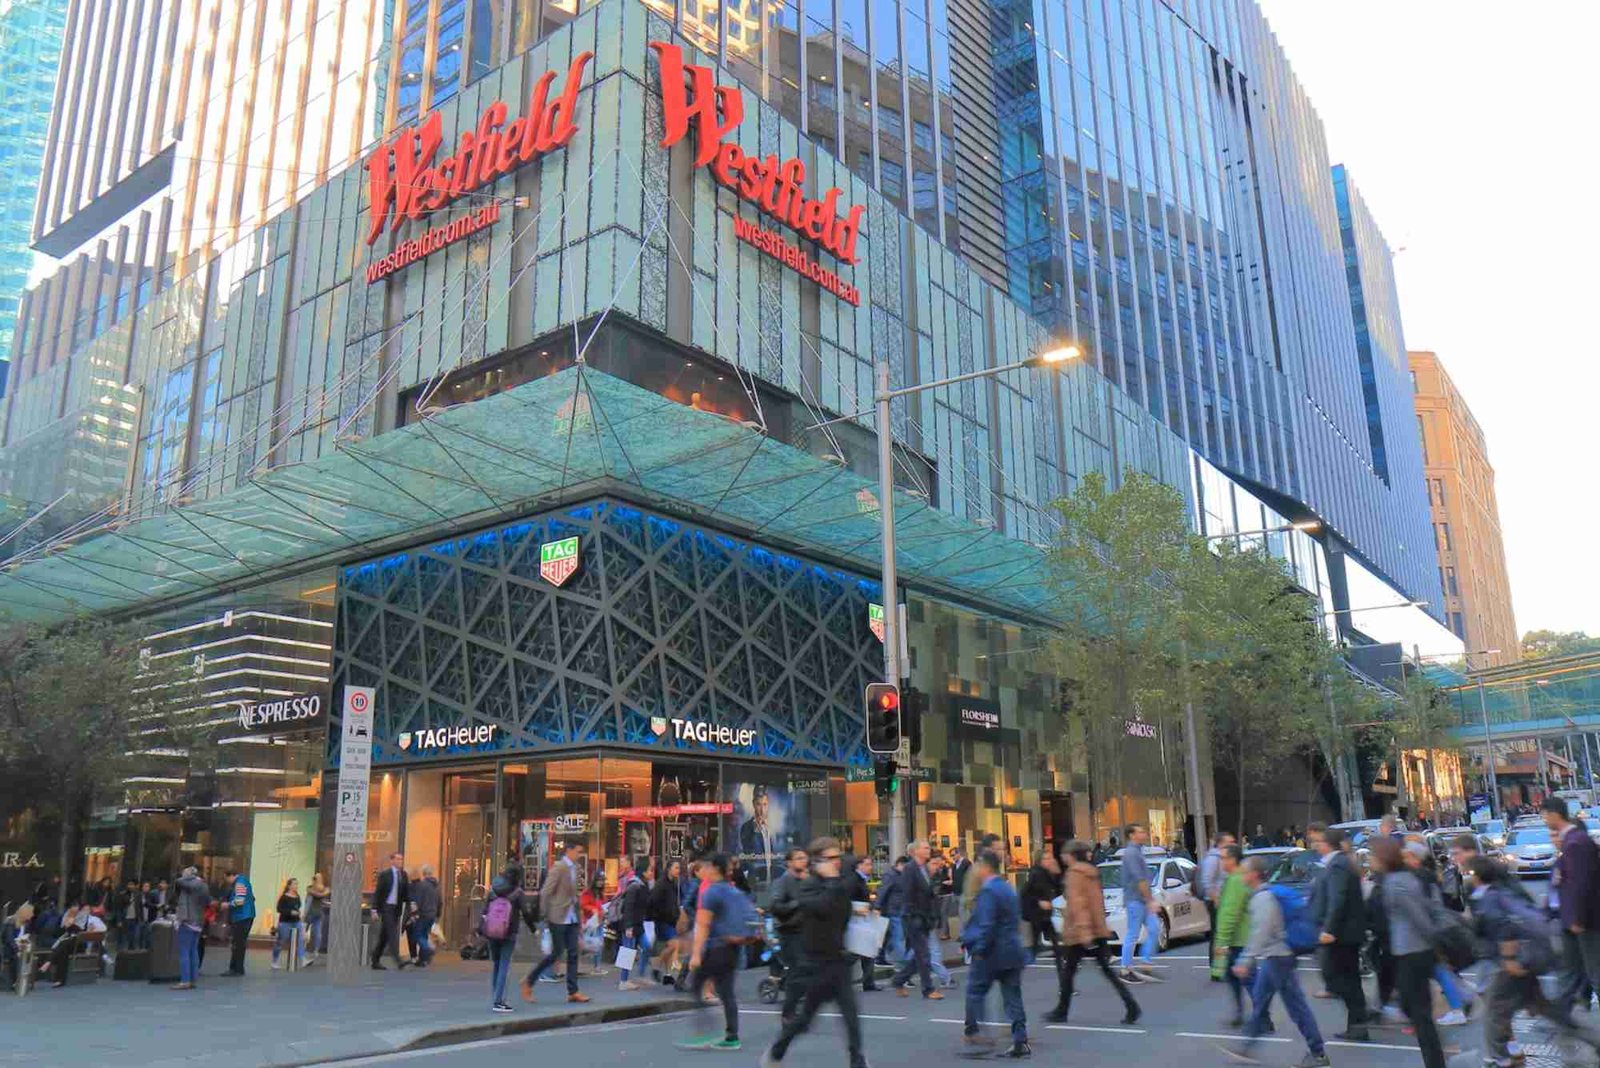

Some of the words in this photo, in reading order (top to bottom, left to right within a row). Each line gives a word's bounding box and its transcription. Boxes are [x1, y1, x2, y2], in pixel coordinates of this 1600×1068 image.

[364, 51, 594, 246] Westfield
[647, 41, 866, 266] Westfield
[365, 200, 500, 285] westfield.com.au
[732, 211, 861, 306] westfield.com.au
[543, 556, 577, 580] HEUER
[544, 540, 576, 560] TAG
[238, 695, 320, 730] NESPRESSO
[556, 814, 585, 829] SALE
